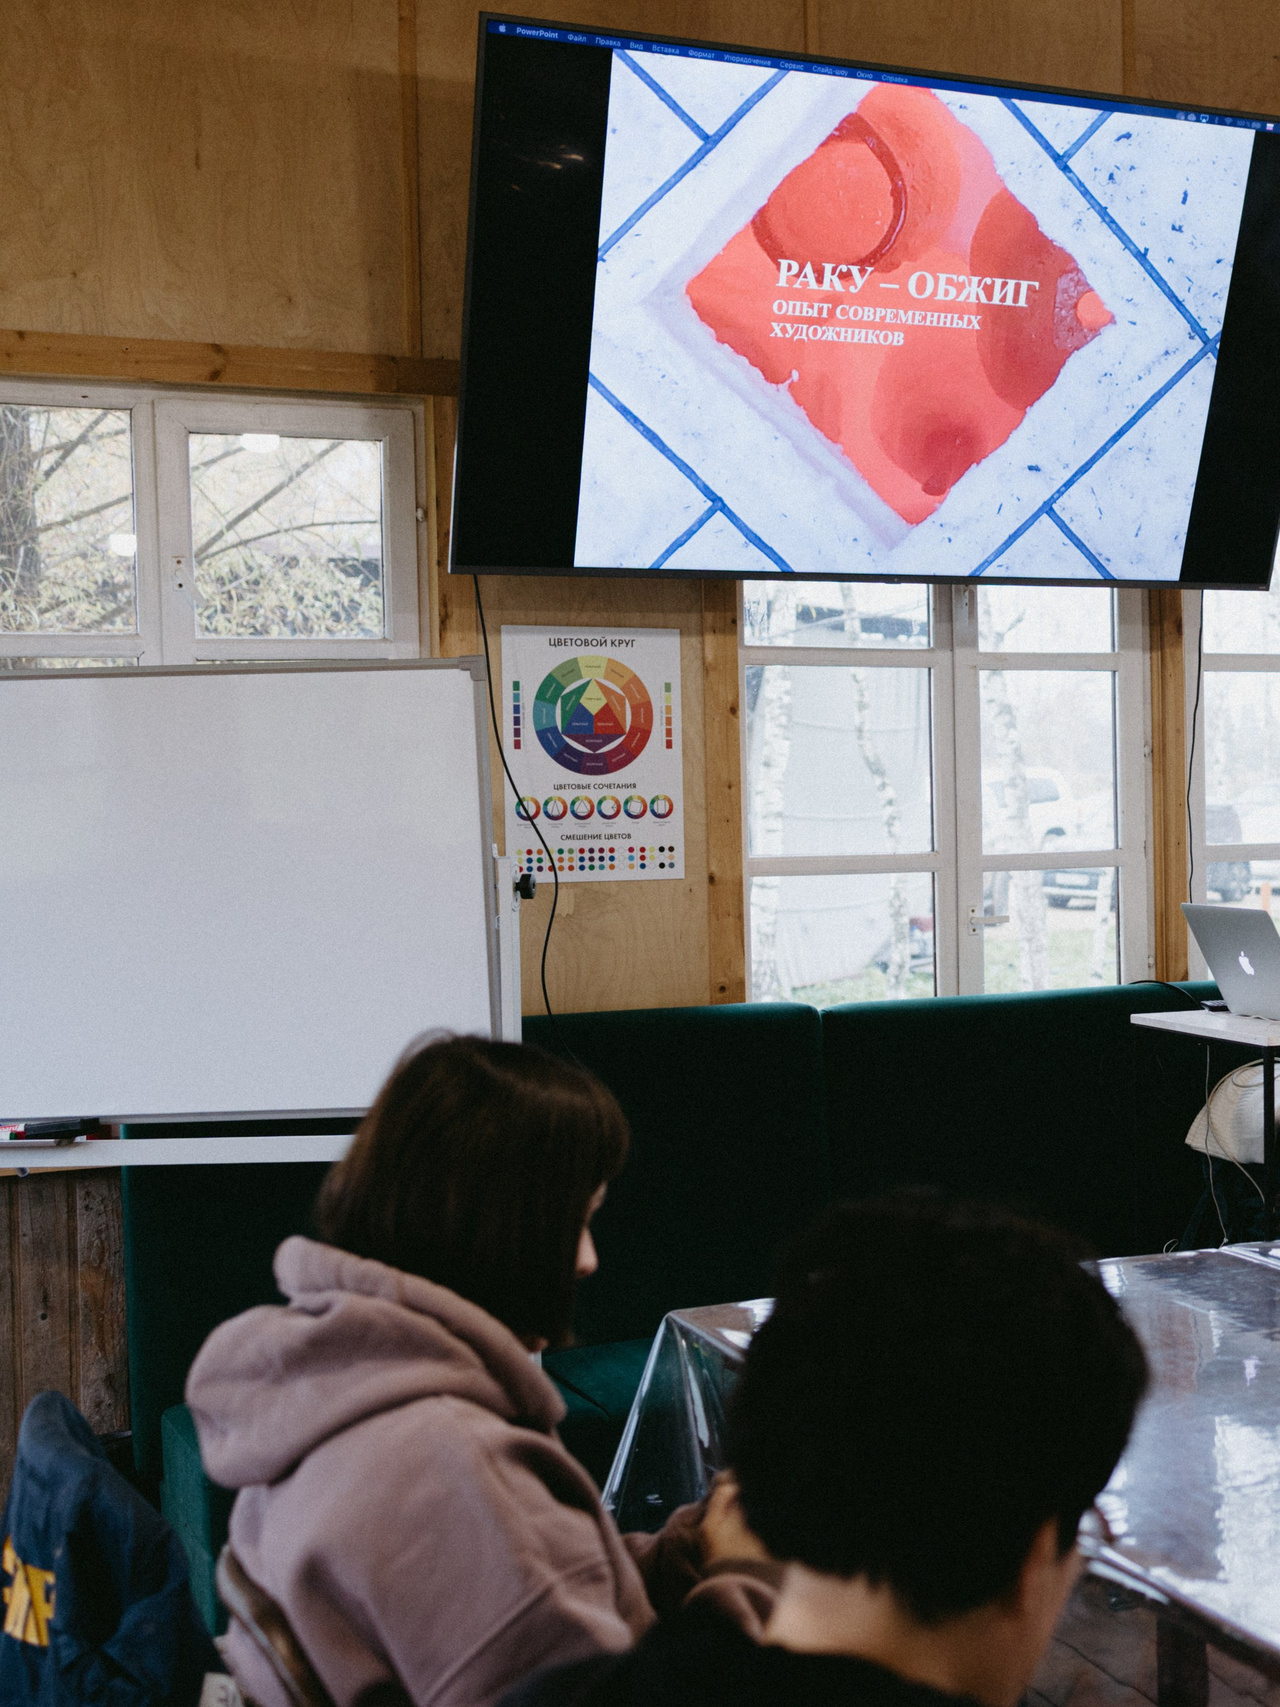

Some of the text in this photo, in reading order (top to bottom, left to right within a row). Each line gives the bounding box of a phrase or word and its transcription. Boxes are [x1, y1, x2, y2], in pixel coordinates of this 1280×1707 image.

[516, 27, 909, 84] PowerPoint Файл Правка Вид Вставка Формат Упорядочение Сервис Слайд-шоу Окно Справка
[775, 258, 874, 294] РАКУ
[907, 270, 1040, 307] ОБЖИГ
[772, 299, 982, 330] ОПЫТ СОВРЕМЕННЫХ
[769, 321, 905, 346] ХУДОЖНИКОВ
[548, 636, 636, 649] ЦВЕТОВОЙ КРУГ
[553, 782, 637, 792] ЦВЕТОВЫЕ СОЧЕТАНИЯ
[560, 833, 632, 841] СМЕШЕНИЕ ЦВЕТОВ
